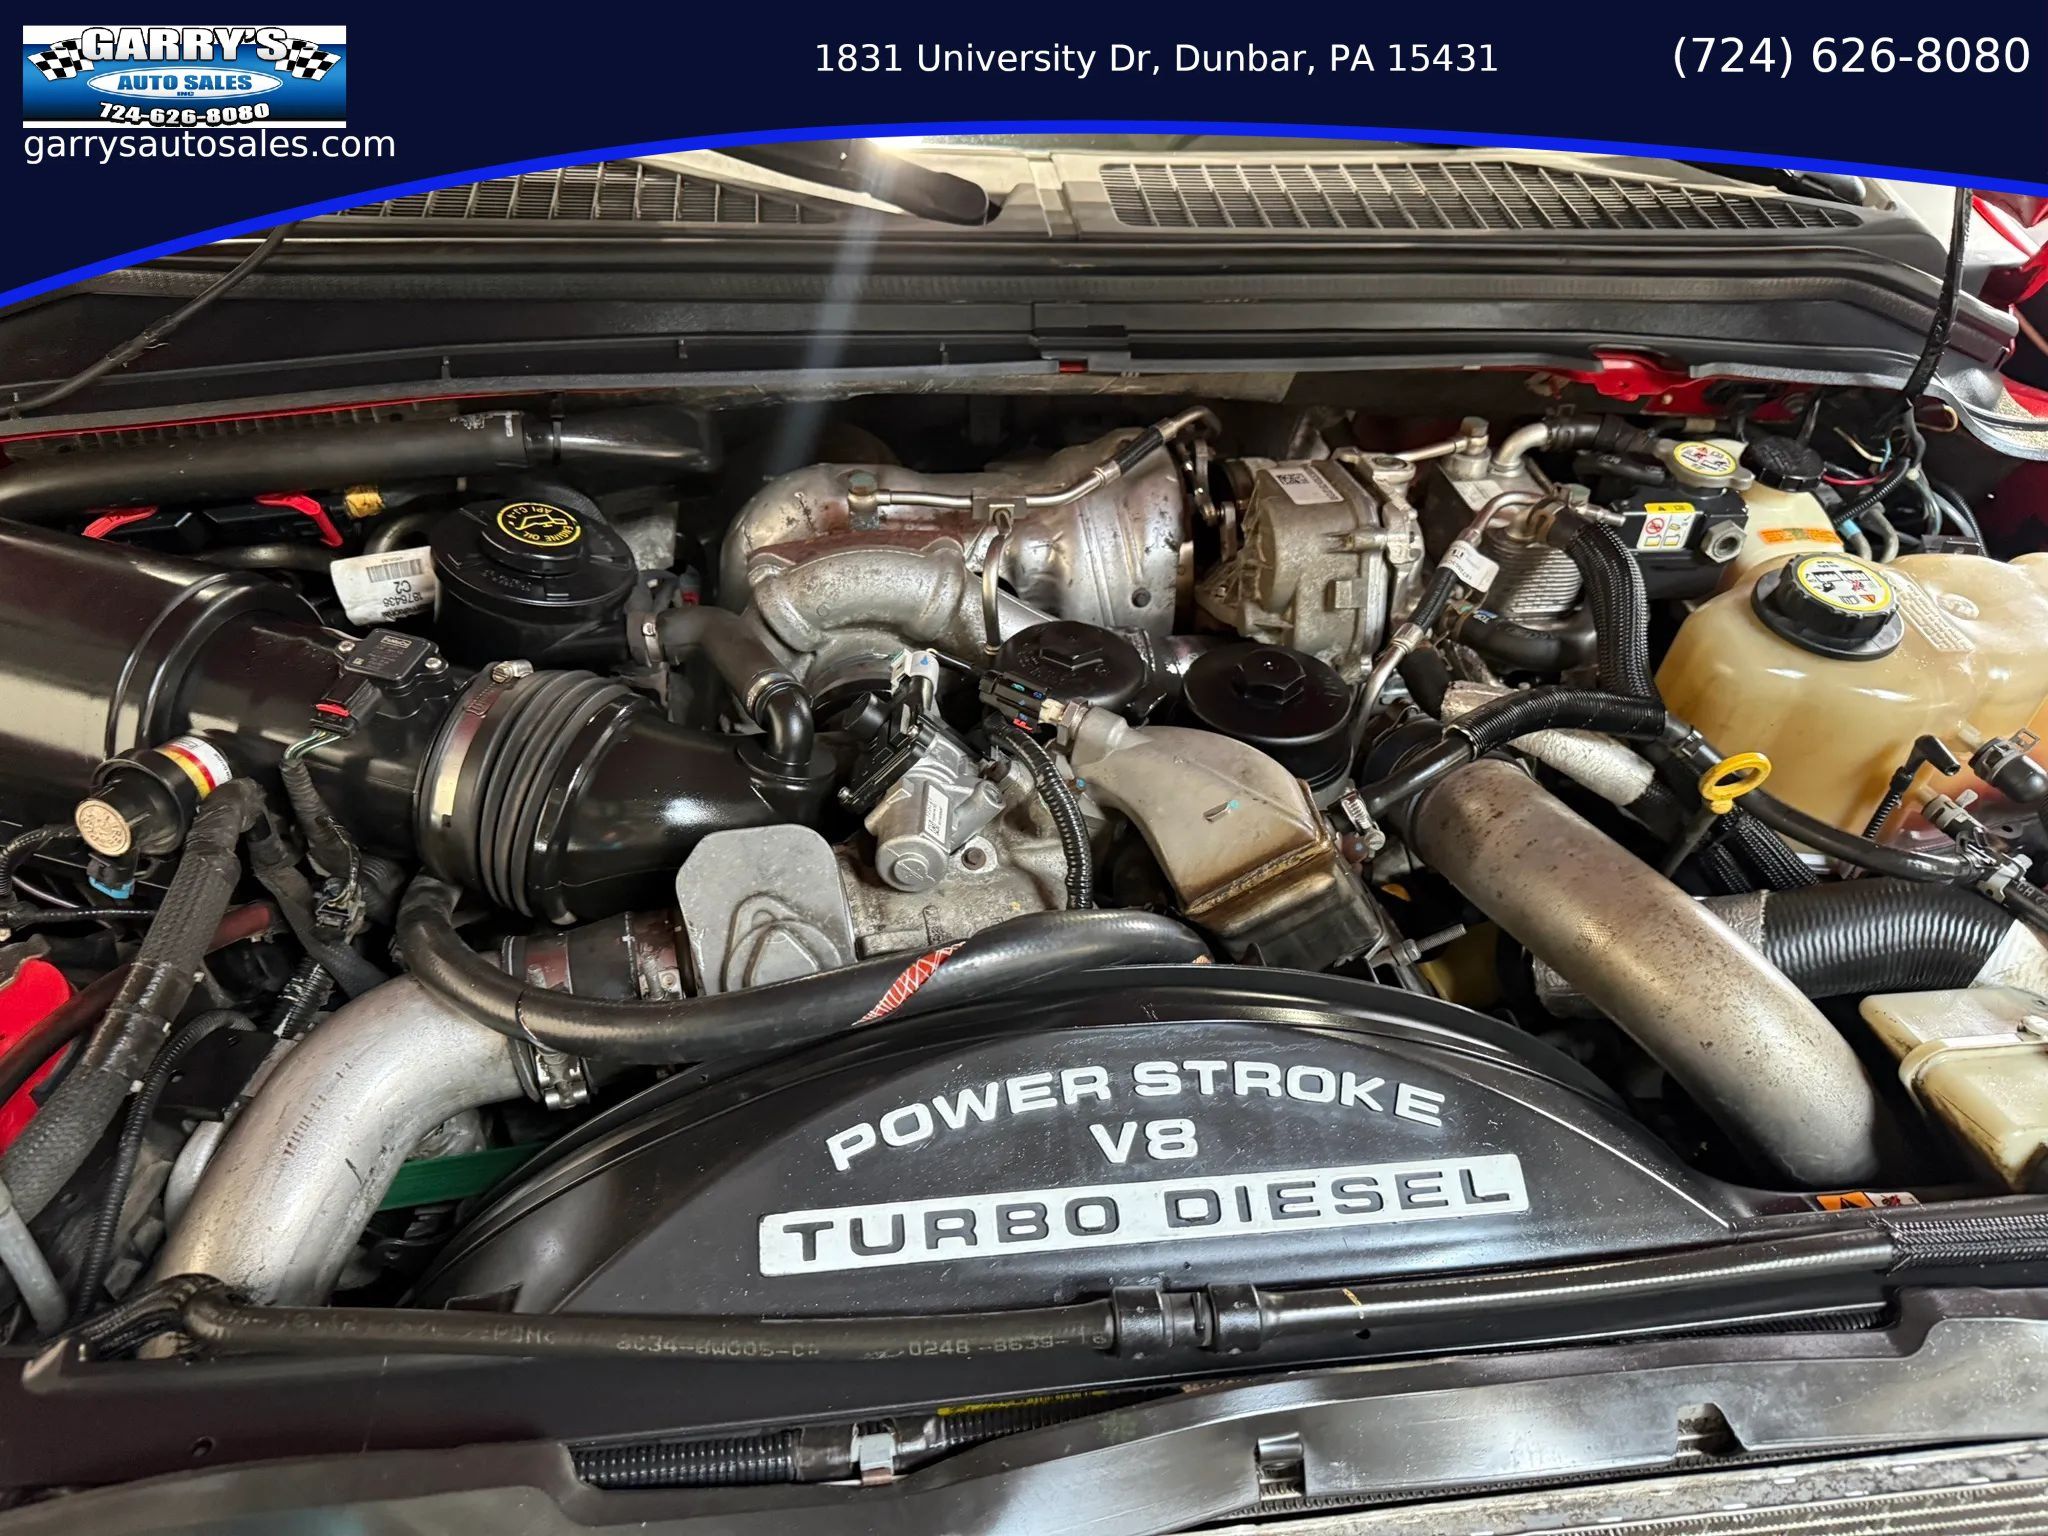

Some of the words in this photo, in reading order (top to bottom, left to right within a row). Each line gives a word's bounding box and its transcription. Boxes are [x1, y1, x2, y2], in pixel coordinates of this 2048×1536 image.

[522, 530, 541, 541] OIL
[543, 525, 574, 543] ENGINE
[393, 580, 411, 594] C2
[826, 1065, 1111, 1172] POWER
[1132, 1060, 1447, 1128] STROKE
[1090, 1118, 1198, 1165] V8
[782, 1195, 1120, 1262] TURBO
[1166, 1167, 1511, 1230] DIESEL
